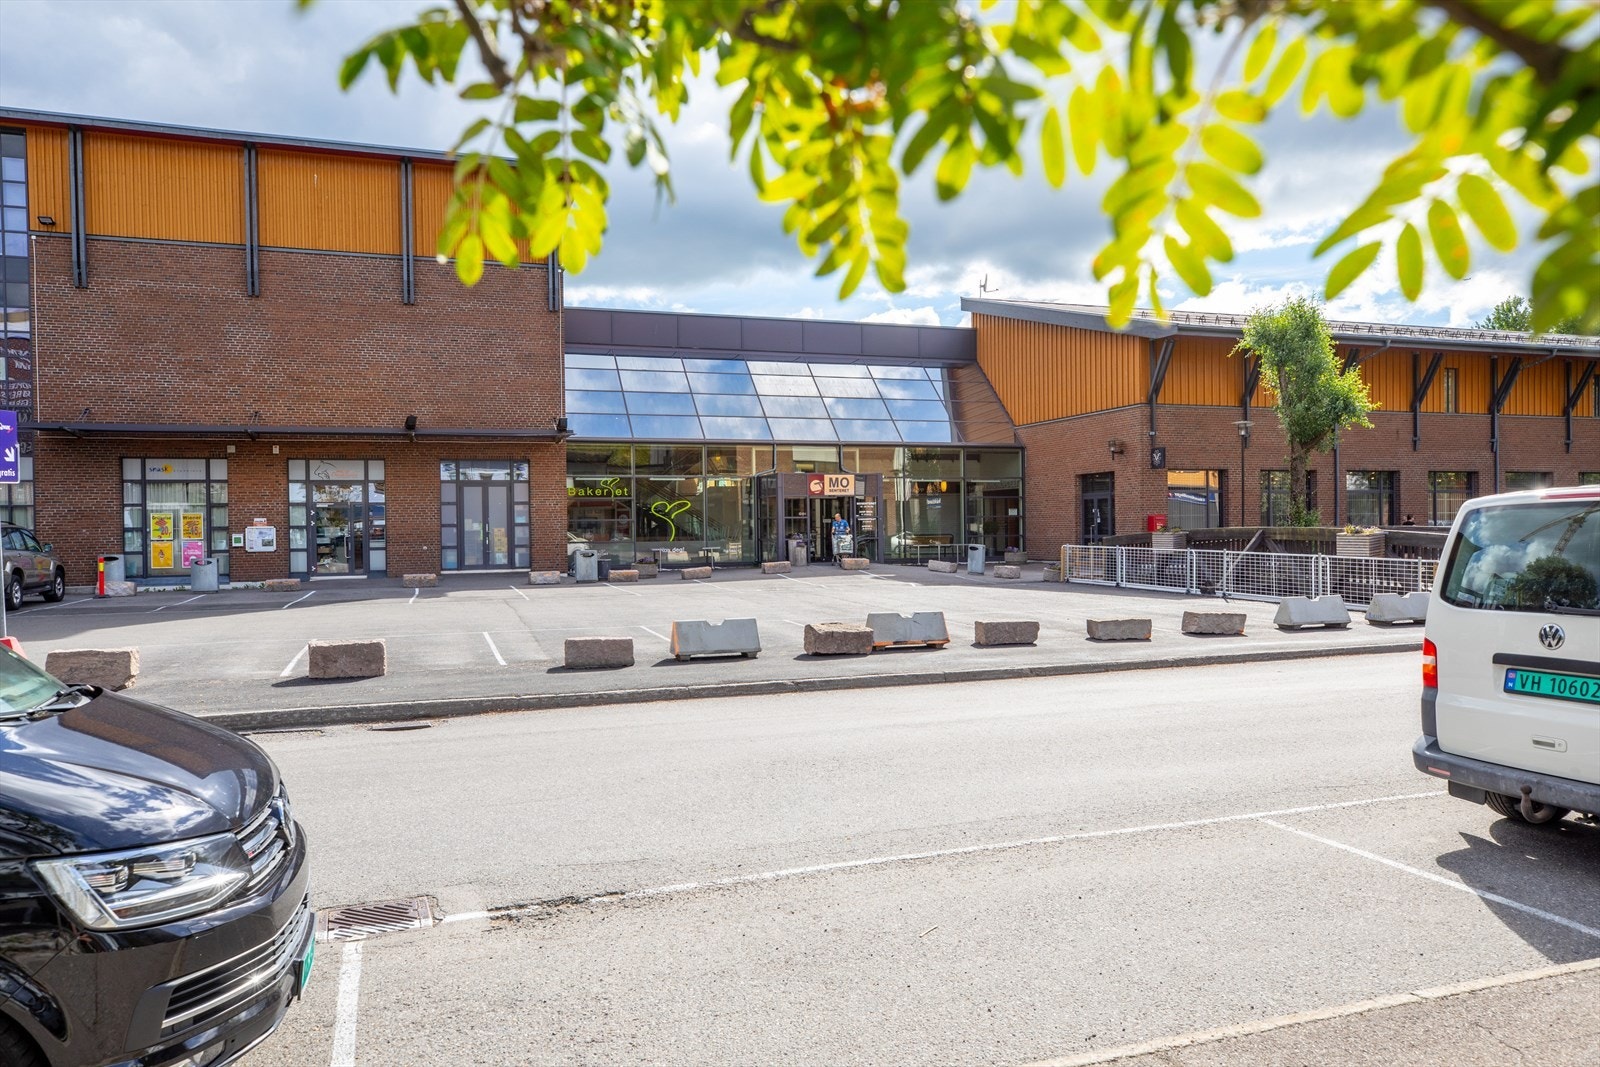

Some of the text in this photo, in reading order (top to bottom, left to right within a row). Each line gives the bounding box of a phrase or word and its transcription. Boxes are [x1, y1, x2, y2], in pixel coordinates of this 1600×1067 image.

[0, 468, 16, 478] ratis
[829, 477, 849, 488] MO
[1520, 674, 1600, 698] VH 10602
